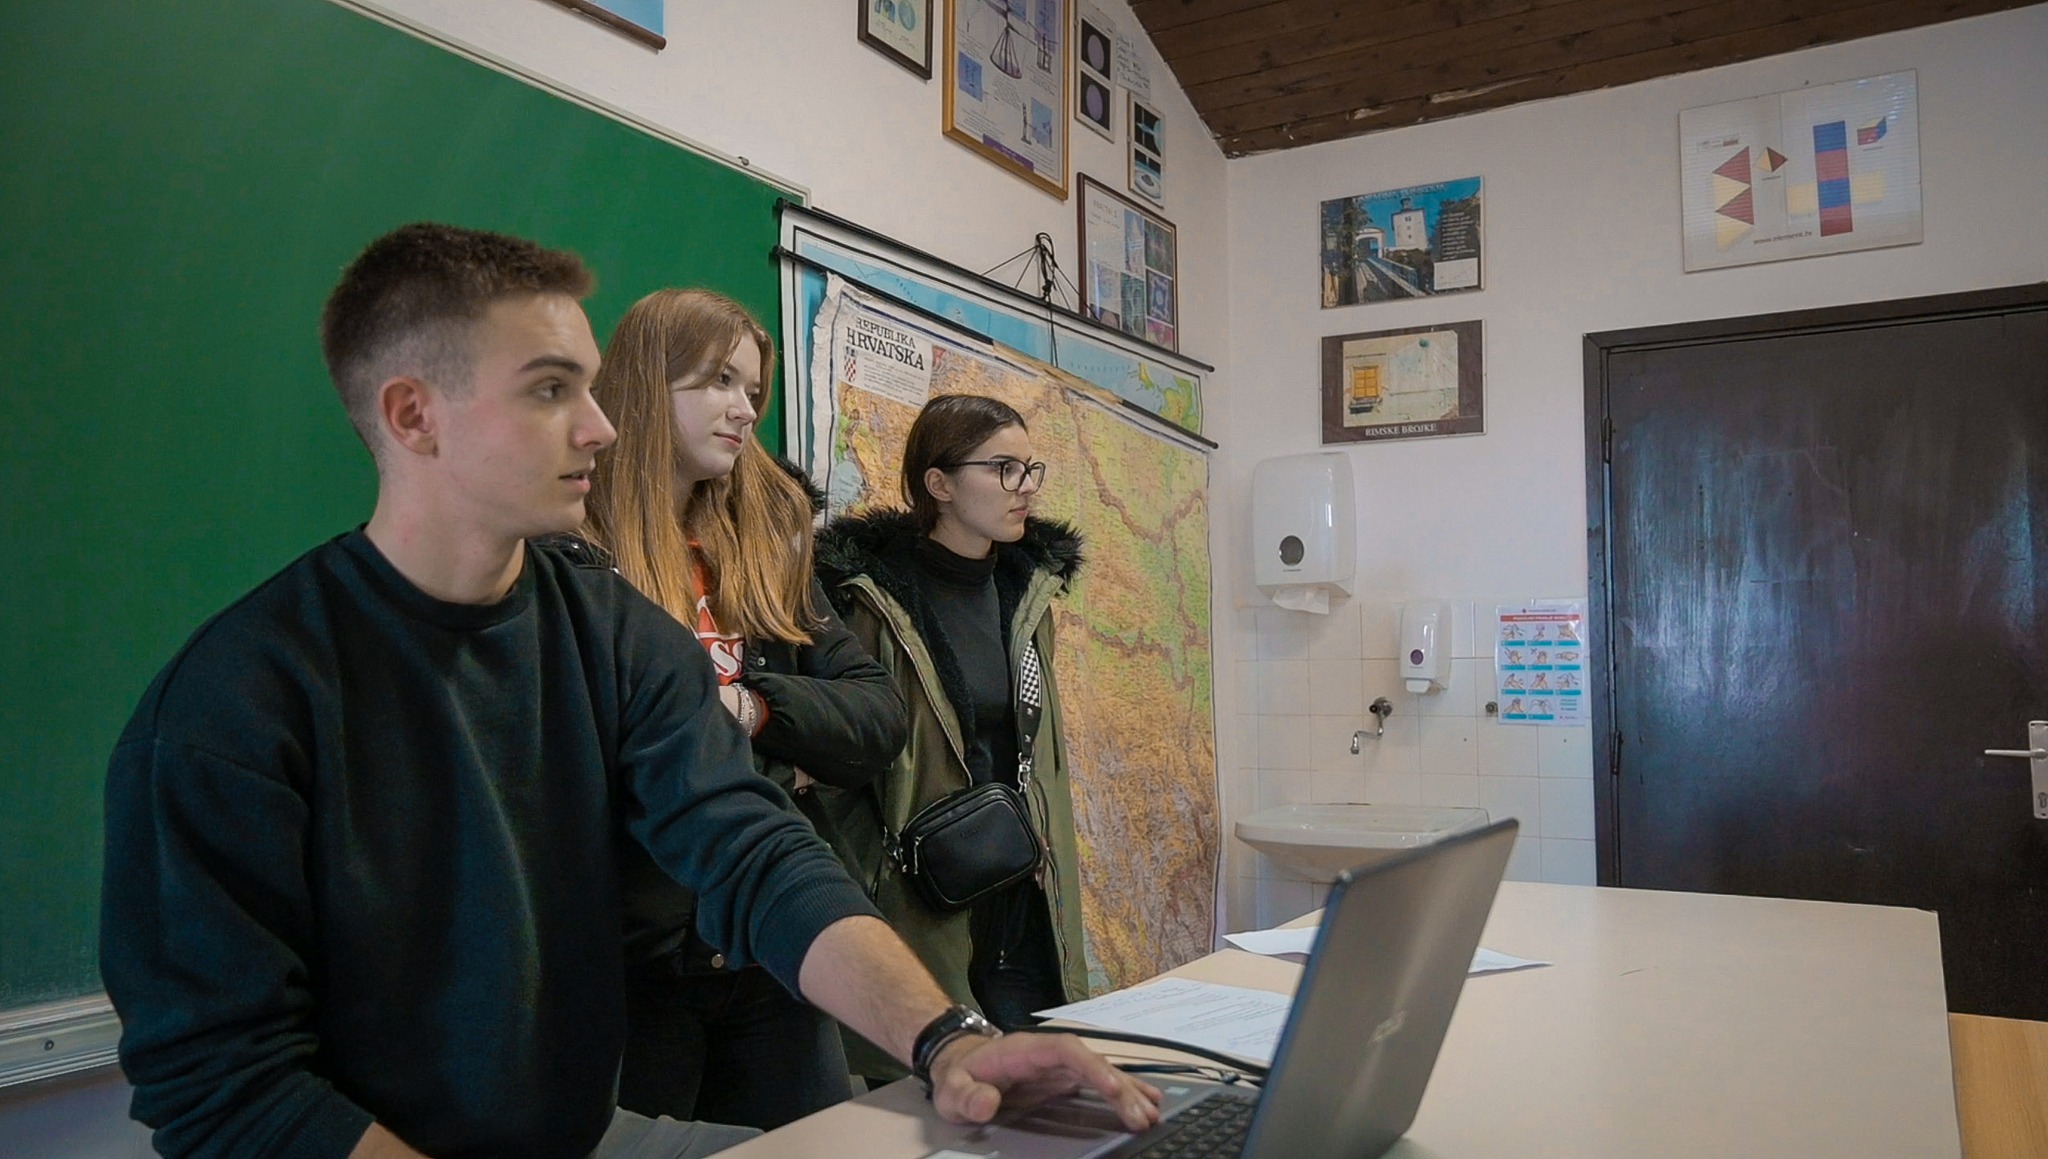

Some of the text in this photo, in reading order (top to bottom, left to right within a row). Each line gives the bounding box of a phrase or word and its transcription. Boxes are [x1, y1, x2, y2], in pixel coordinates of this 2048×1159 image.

[846, 326, 925, 371] HRVATSKA
[855, 317, 916, 349] REPUBLIKA
[1365, 423, 1437, 437] RIMSKE BROJKE
